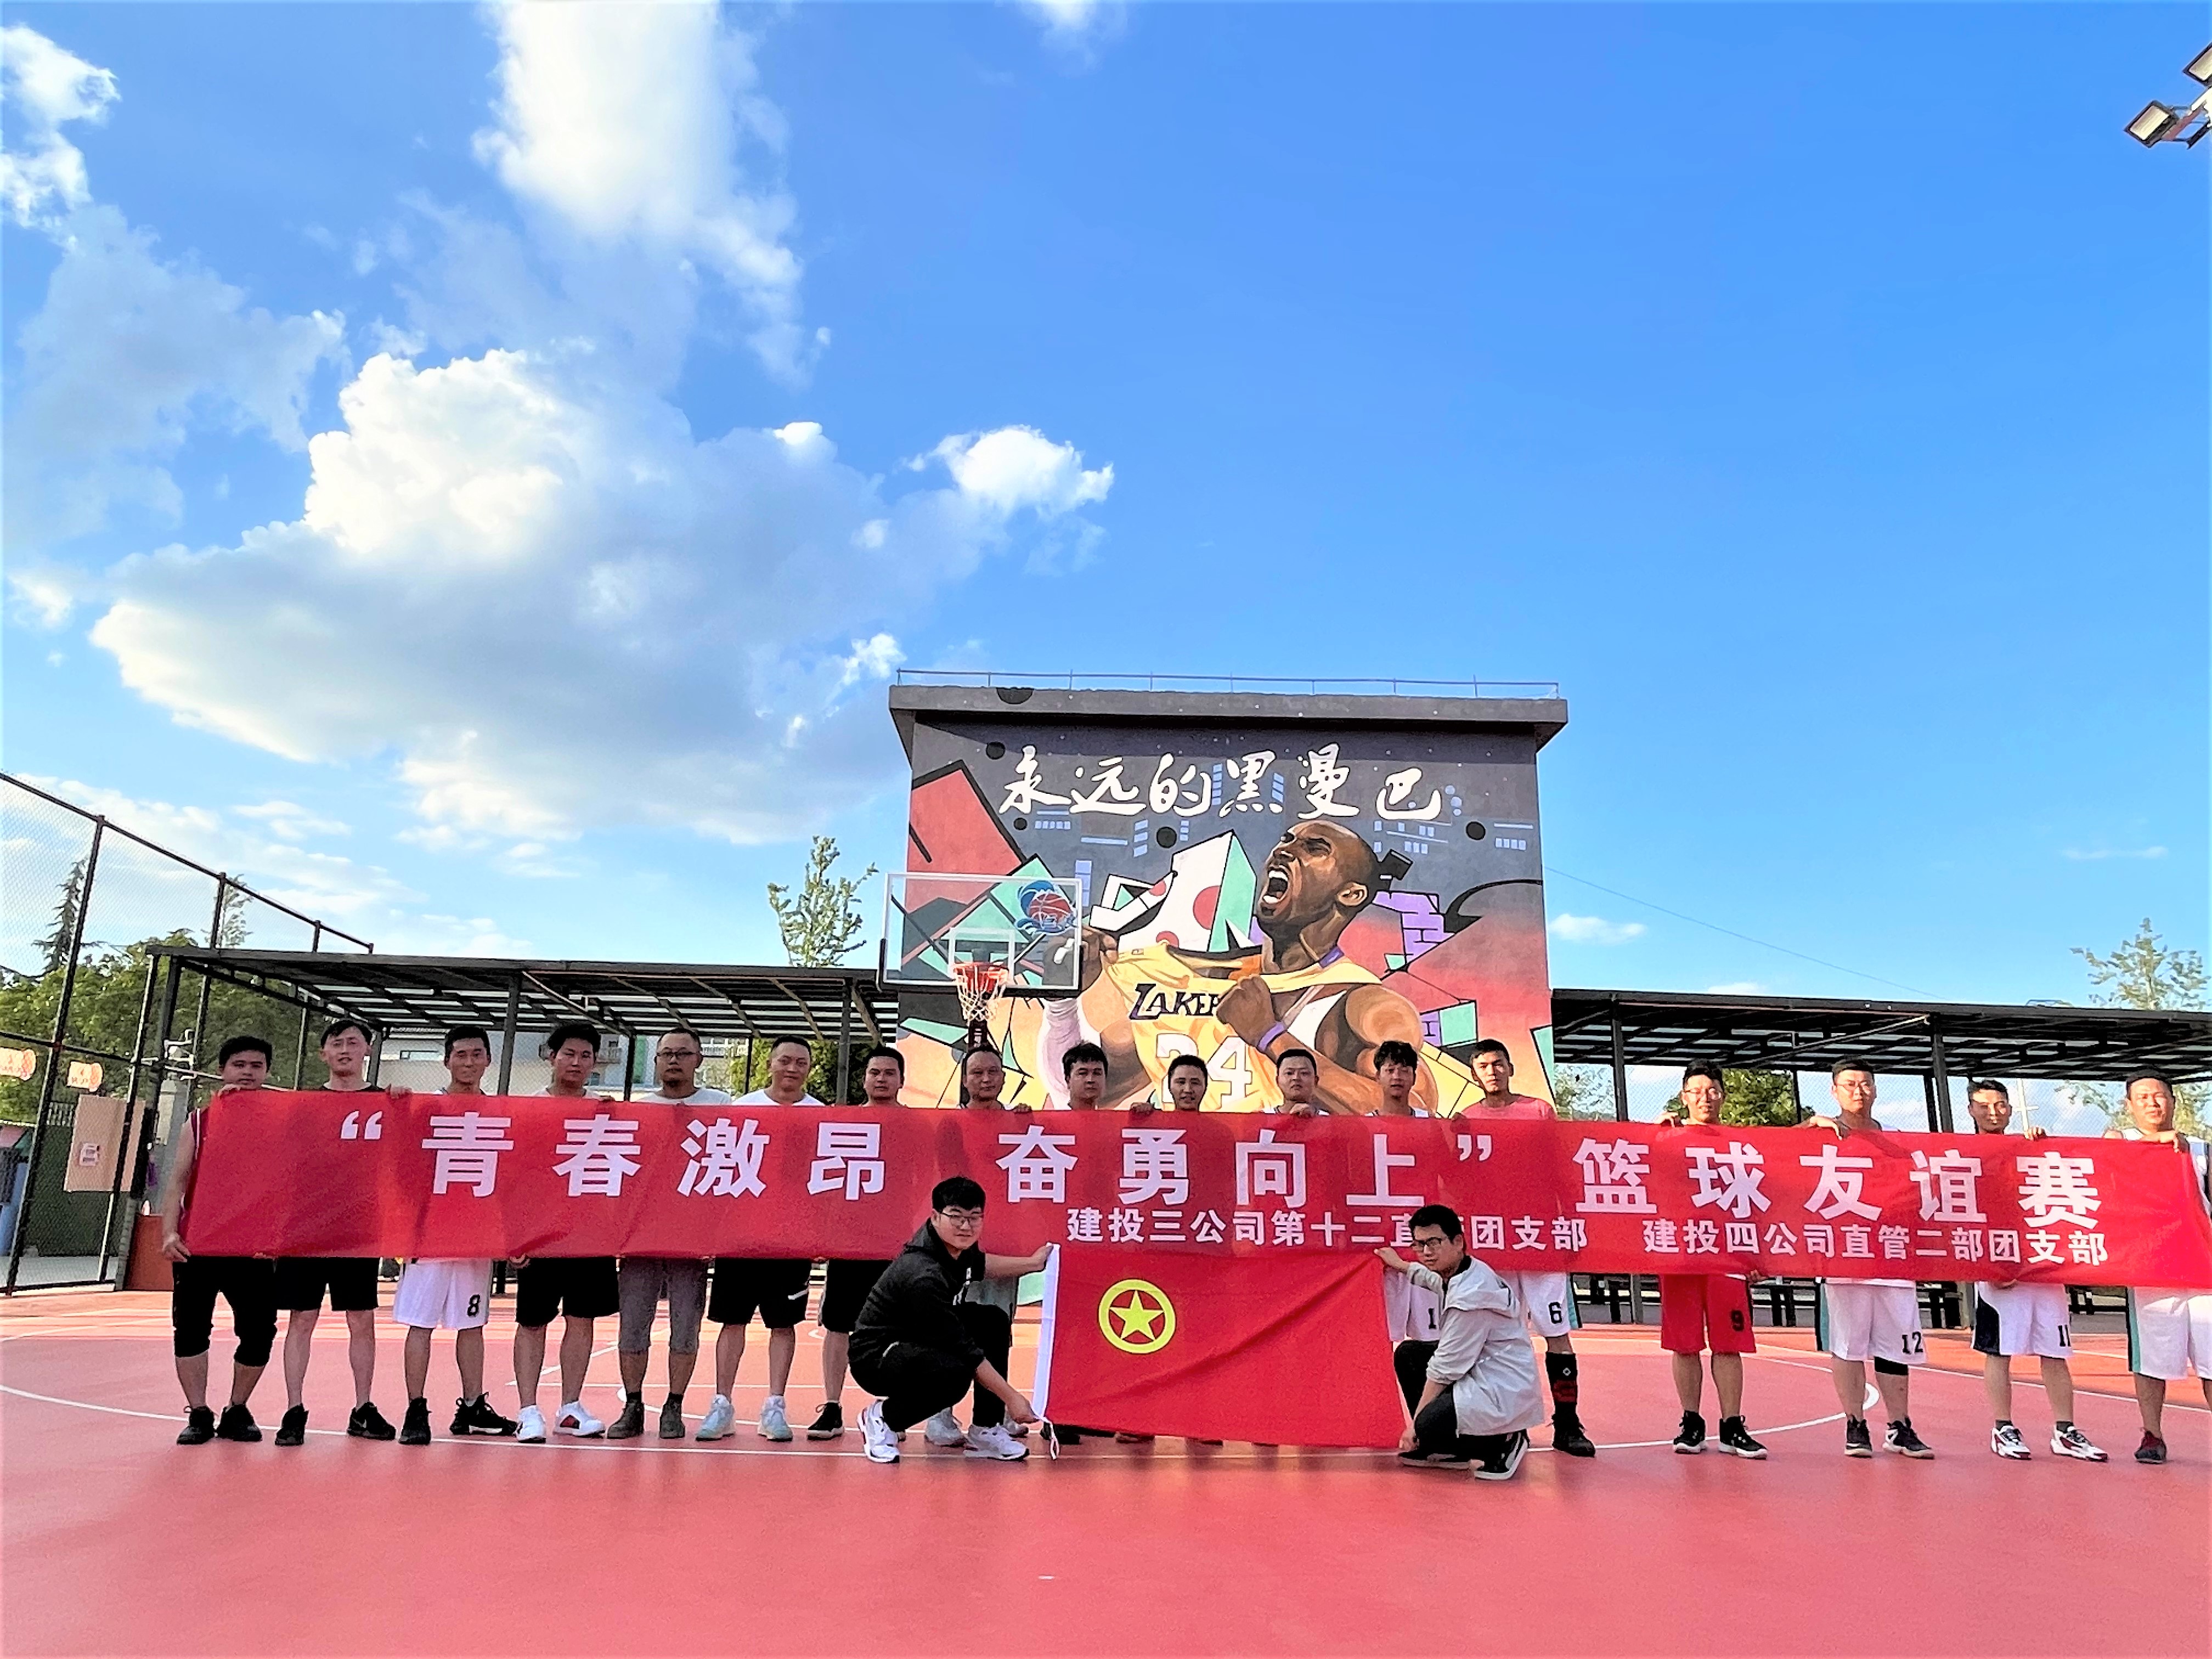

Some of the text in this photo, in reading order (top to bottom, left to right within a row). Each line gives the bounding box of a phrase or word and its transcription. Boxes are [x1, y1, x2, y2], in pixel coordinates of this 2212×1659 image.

[999, 744, 1441, 820] 永远的黑曼巴
[1573, 1137, 2102, 1229] 篮球友谊赛
[1067, 1207, 2108, 1266] 建投三公司第十二直团支部 建投四公司直管二部团支部
[467, 1294, 481, 1317] 8
[1548, 1301, 1562, 1324] 6
[1731, 1310, 1744, 1331] 9
[1901, 1331, 1923, 1355] 12
